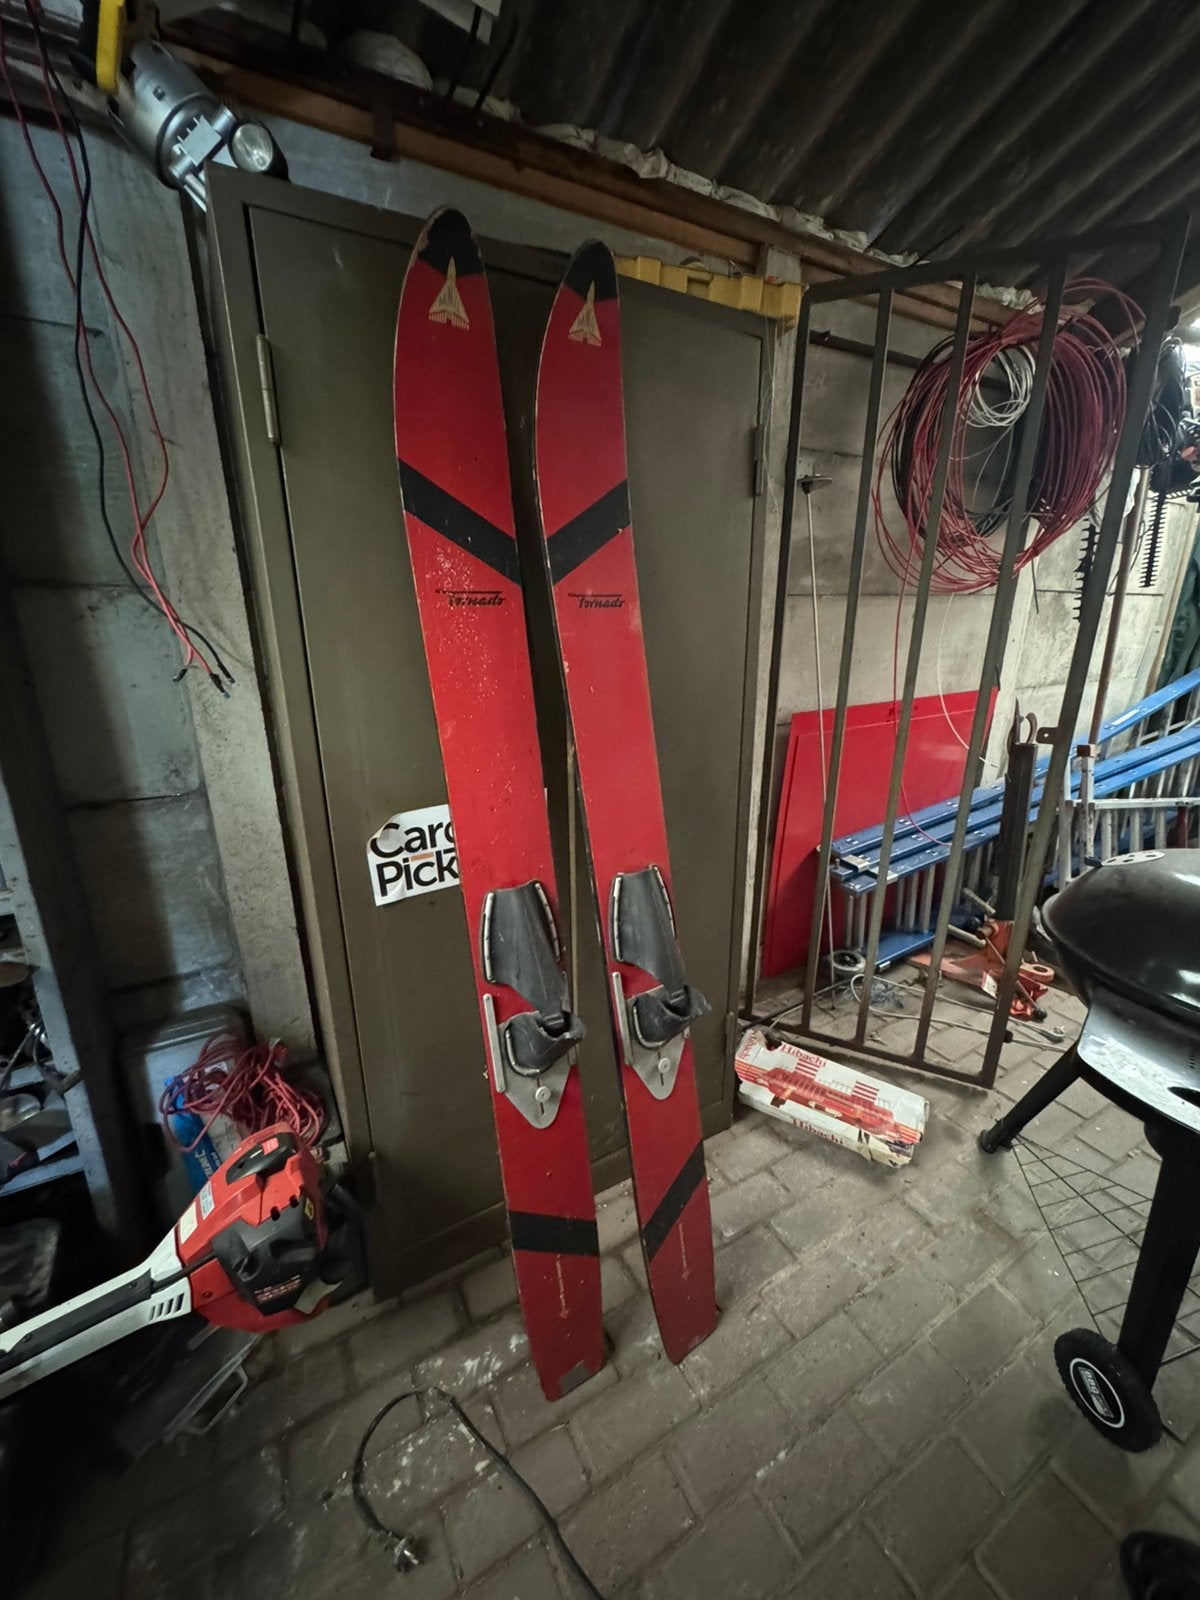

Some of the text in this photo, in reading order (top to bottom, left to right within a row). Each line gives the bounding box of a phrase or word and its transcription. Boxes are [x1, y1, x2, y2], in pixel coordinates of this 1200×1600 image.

[568, 592, 625, 608] Tornado
[376, 848, 459, 897] Pick
[780, 1042, 827, 1068] Hibachi
[790, 1115, 843, 1146] Hibachi
